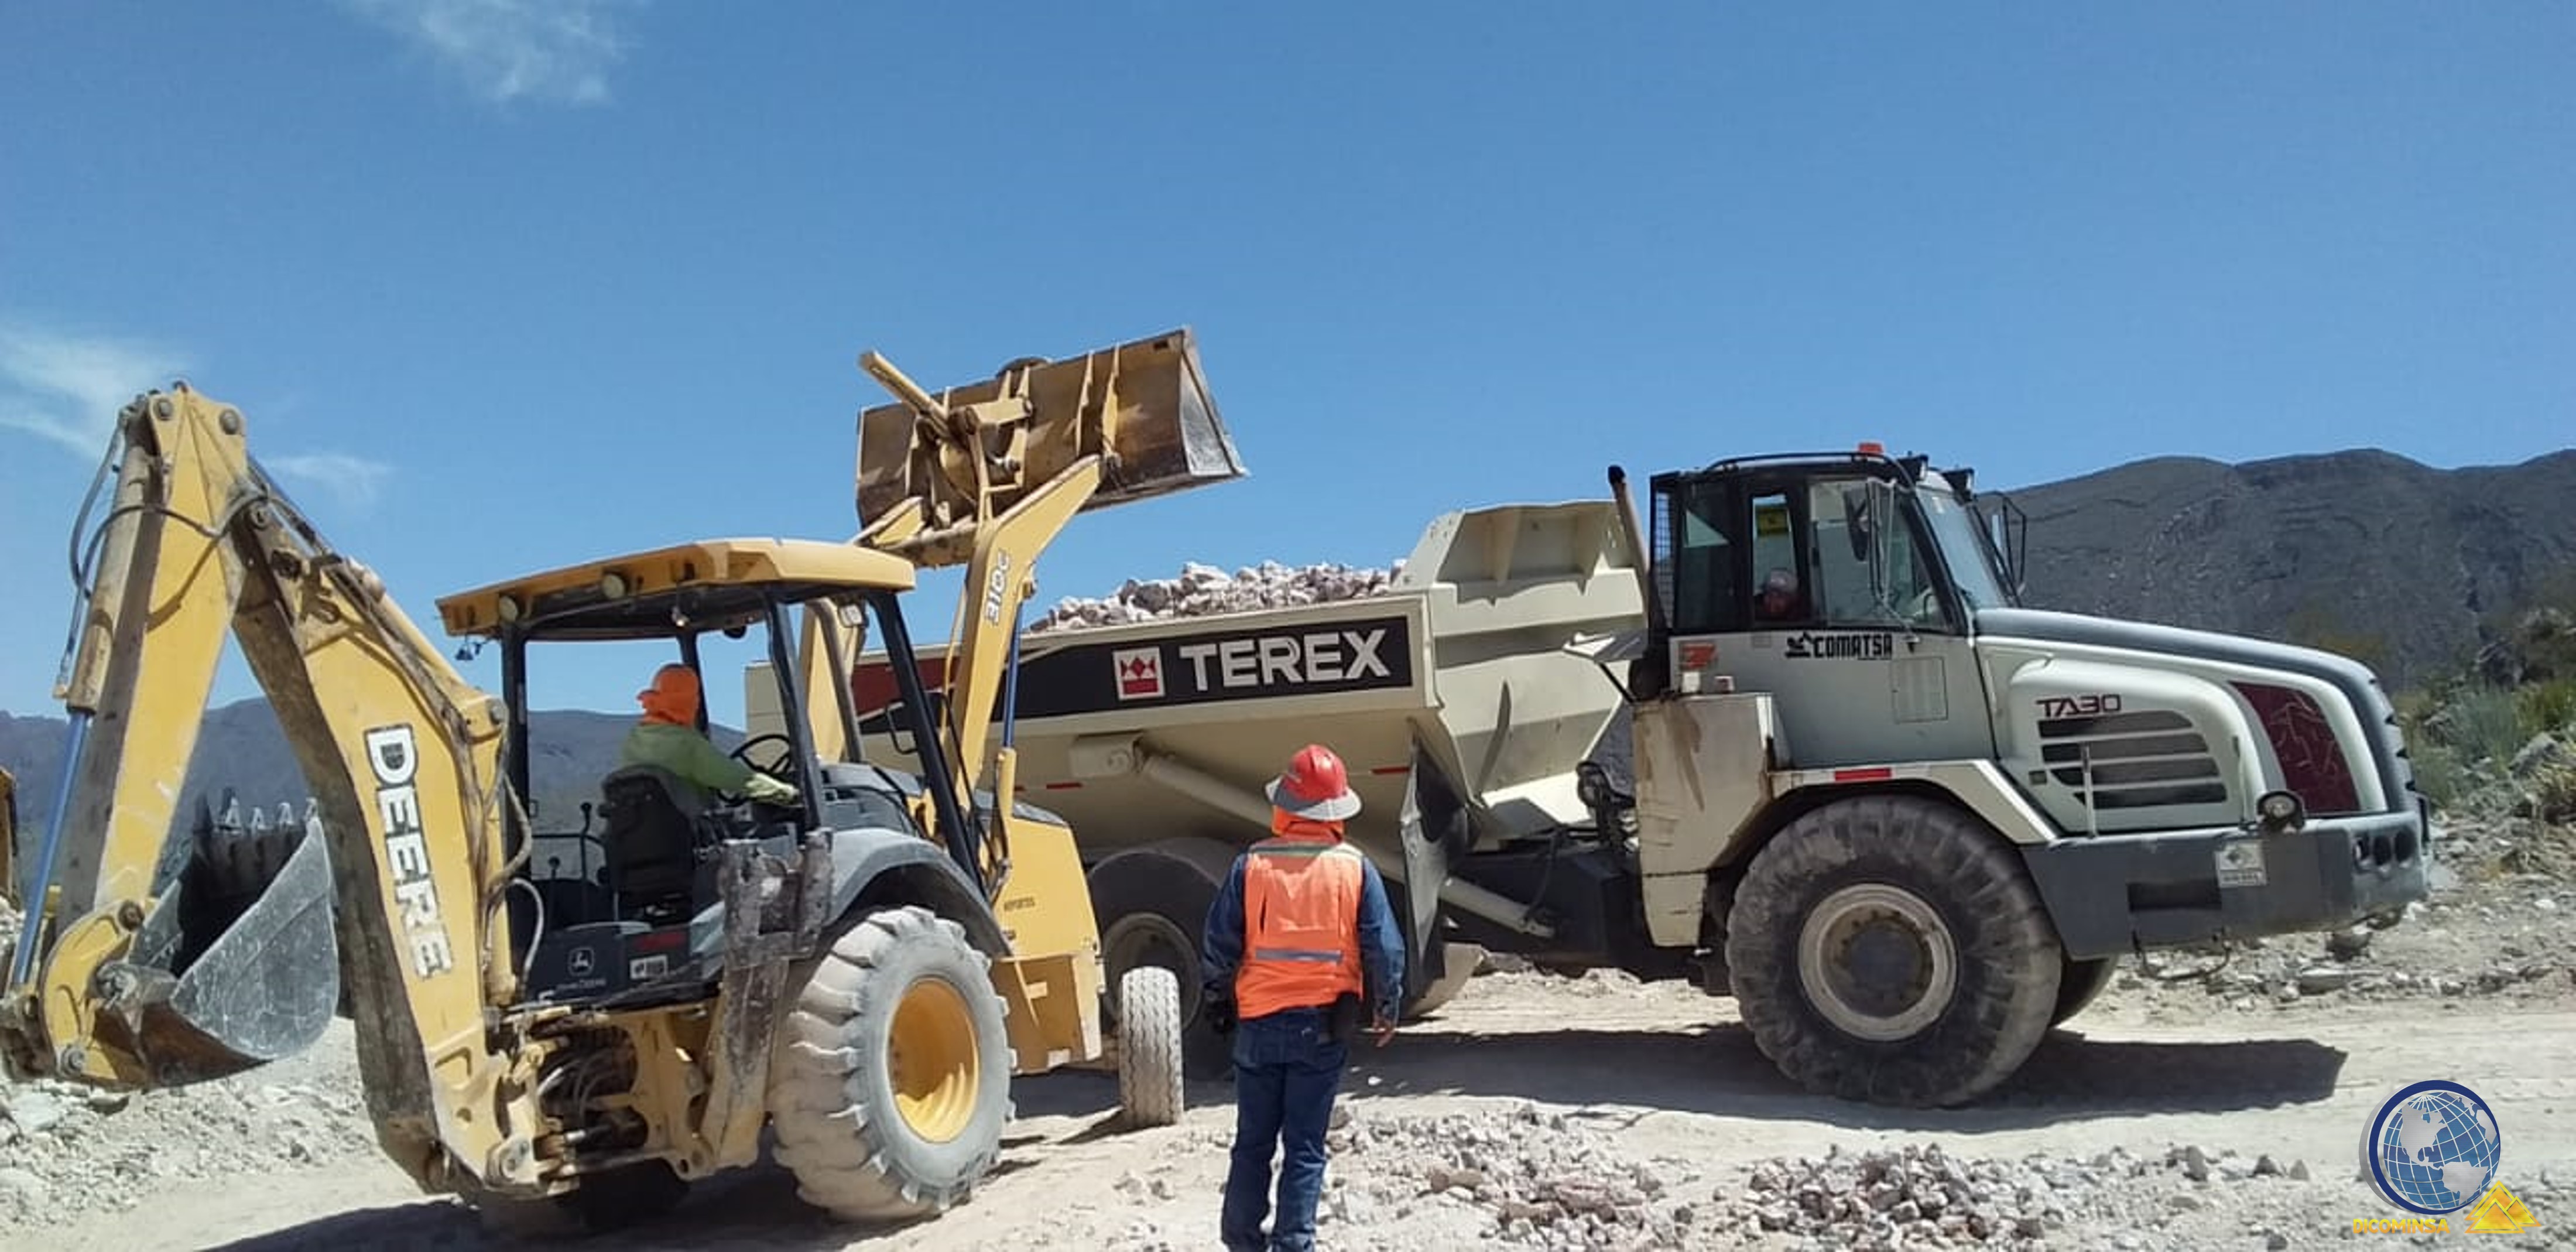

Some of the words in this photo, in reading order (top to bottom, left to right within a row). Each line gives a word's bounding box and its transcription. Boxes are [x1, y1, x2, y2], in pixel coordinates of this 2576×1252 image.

[1180, 630, 1390, 691] TEREX
[1815, 634, 1892, 658] COMATSA
[2036, 694, 2121, 717] TA30
[364, 724, 453, 978] DEERE
